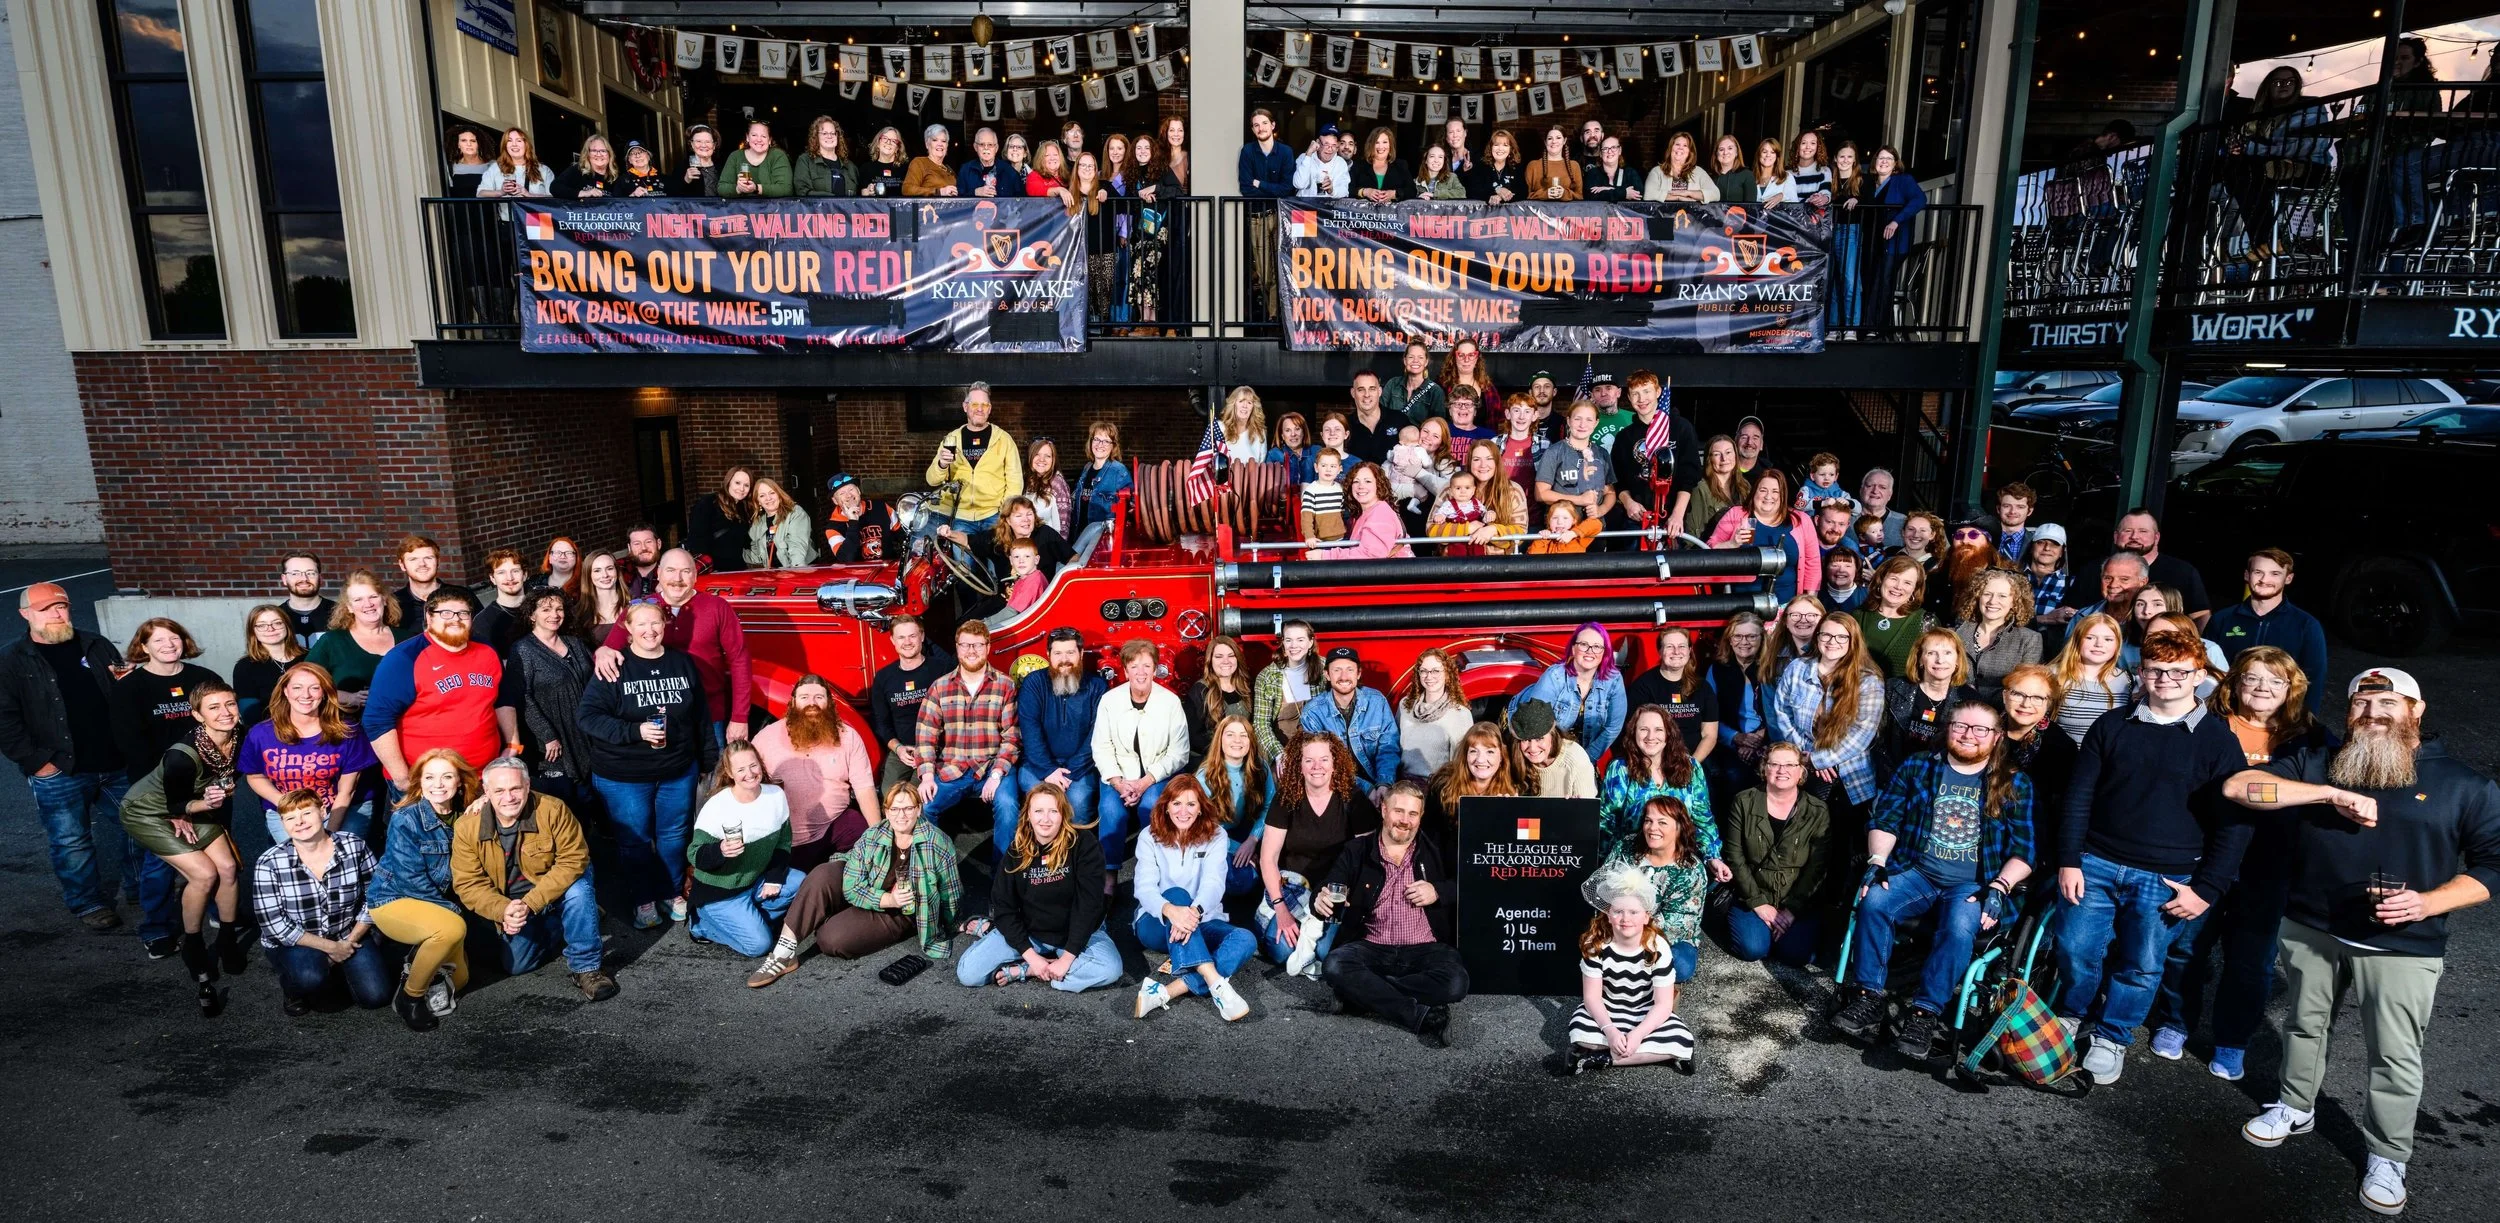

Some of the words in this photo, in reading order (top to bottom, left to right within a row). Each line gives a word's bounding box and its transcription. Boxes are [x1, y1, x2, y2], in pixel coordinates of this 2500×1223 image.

[762, 64, 786, 72] GUINNESS
[842, 67, 866, 75] GUINNESS
[566, 211, 583, 221] THE
[584, 212, 623, 221] LEAGUE
[1332, 209, 1348, 220] THE
[1349, 211, 1386, 221] LEAGUE
[1388, 213, 1397, 221] OF
[559, 221, 643, 232] EXTRAORDINARY
[646, 213, 707, 239] NIGHT
[709, 219, 724, 236] OF
[727, 216, 749, 233] THE
[750, 213, 847, 239] WALKING
[852, 213, 890, 238] RED
[1323, 219, 1405, 232] EXTRAORDINARY
[1409, 214, 1468, 239] NIGHT
[1469, 223, 1484, 238] OF
[1487, 217, 1508, 234] THE
[1510, 215, 1603, 241] WALKING
[1606, 216, 1645, 241] RED
[575, 232, 595, 243] RED
[1337, 229, 1358, 241] RED
[530, 250, 637, 293] BRING
[647, 250, 717, 294] OUT
[727, 250, 822, 294] YOUR
[834, 250, 913, 294] RED!
[1291, 247, 1395, 290] BRING
[1407, 248, 1476, 291] OUT
[1485, 251, 1576, 293] YOUR
[1587, 252, 1664, 294] RED!
[931, 280, 1004, 299] RYAN'S
[1010, 280, 1075, 299] WAKE
[1677, 283, 1748, 301] RYAN'S
[1755, 283, 1813, 301] WAKE
[953, 301, 994, 310] PUBLIC
[1013, 300, 1054, 310] HOUSE
[1292, 297, 1337, 323] KICK
[1460, 298, 1520, 324] WAKE:
[1697, 303, 1736, 312] PUBLIC
[1754, 304, 1793, 313] HOUSE
[536, 299, 581, 325] KICK
[705, 301, 768, 326] WAKE:
[771, 301, 805, 326] 5PM
[1749, 329, 1812, 338] MISUNDERSTOOD
[2028, 321, 2129, 347] THIRSTY
[434, 673, 464, 695] RED
[469, 672, 495, 689] SOX
[623, 676, 690, 696] BETHLEHEM
[636, 690, 683, 708] EAGLES
[263, 748, 341, 770] Ginger
[1484, 842, 1505, 854] THE
[1507, 843, 1558, 855] LEAGUE
[1560, 844, 1573, 854] OF
[1473, 853, 1583, 868] EXTRAORDINARY
[1043, 875, 1064, 884] HEADS
[1490, 866, 1517, 880] RED
[1495, 907, 1551, 920] Agenda:
[1503, 923, 1516, 937] 1)
[1519, 923, 1537, 935] Us
[1502, 940, 1515, 953] 2)
[1519, 939, 1556, 951] Them
